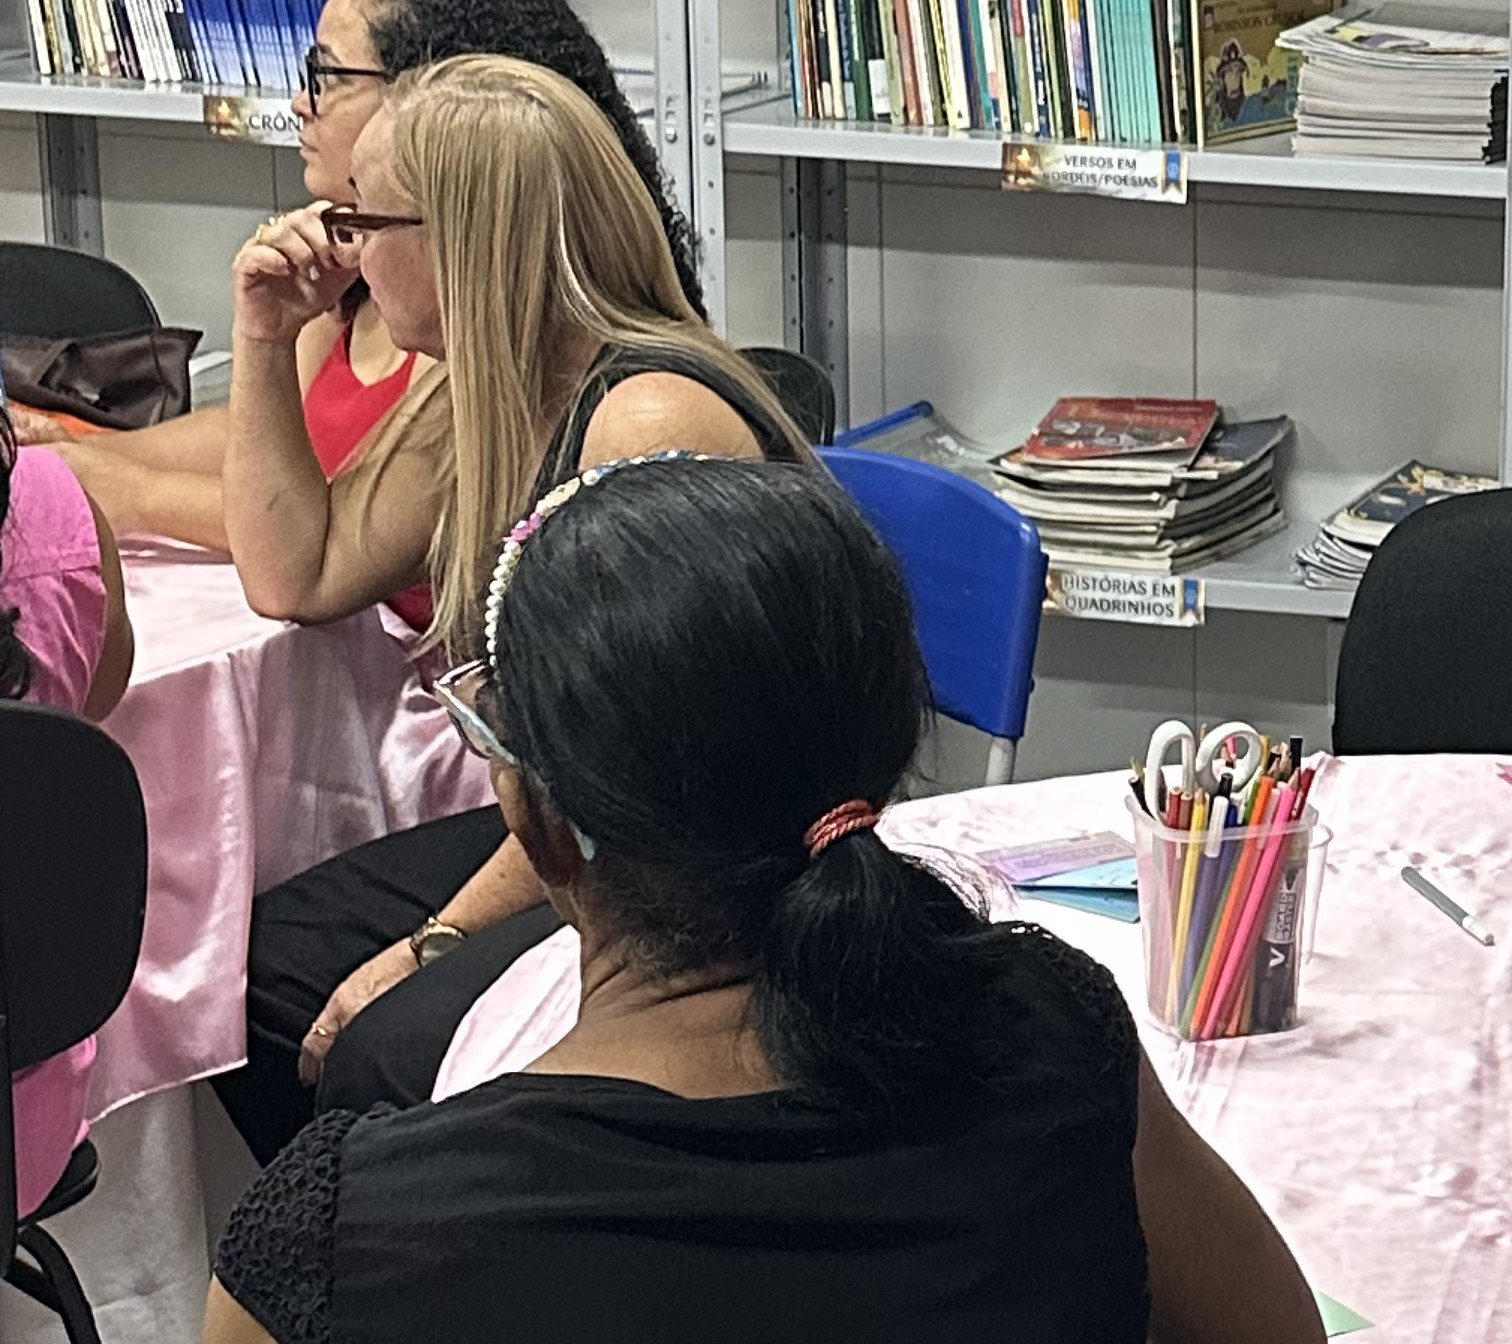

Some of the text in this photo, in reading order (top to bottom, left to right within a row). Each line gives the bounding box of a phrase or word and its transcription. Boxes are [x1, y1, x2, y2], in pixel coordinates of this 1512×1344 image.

[248, 112, 300, 132] CRÔN
[1064, 155, 1137, 171] VERSOS EM
[1064, 574, 1176, 597] HISTÓRIAS EM
[1065, 596, 1175, 617] QUADRINHOS
